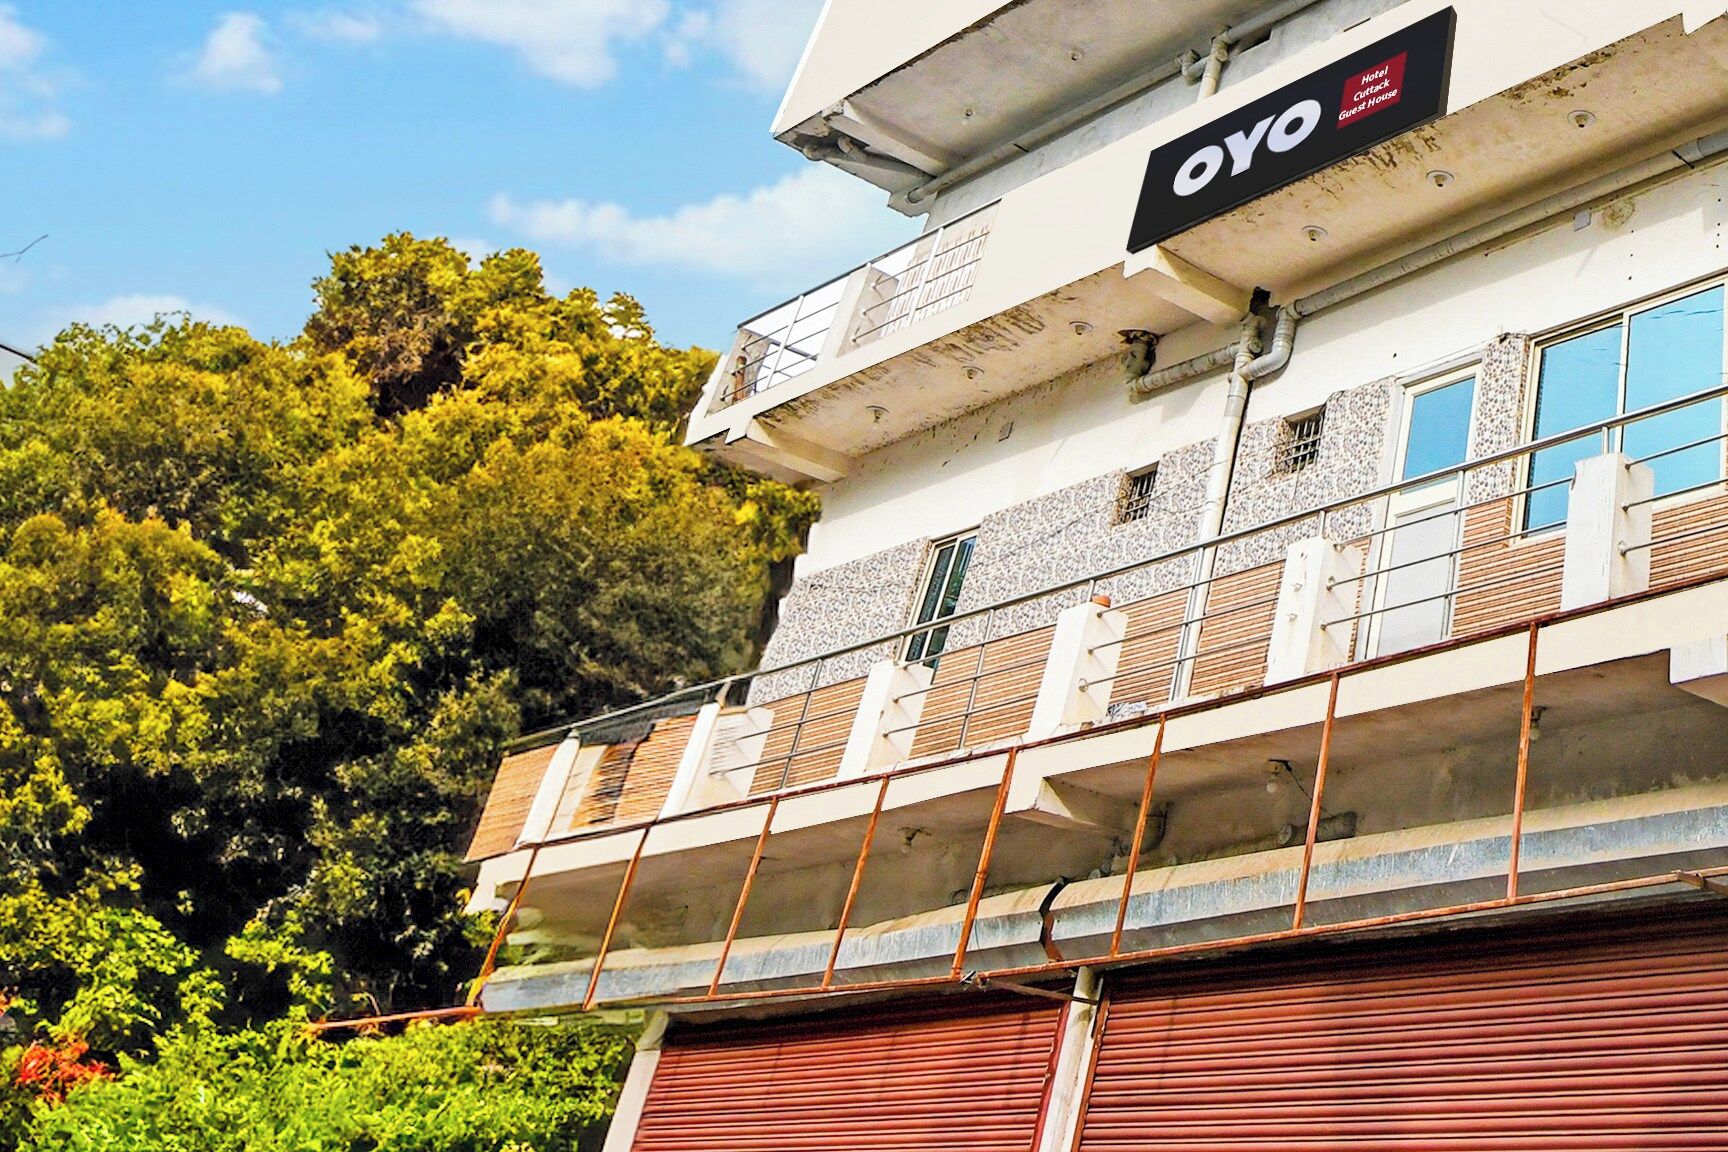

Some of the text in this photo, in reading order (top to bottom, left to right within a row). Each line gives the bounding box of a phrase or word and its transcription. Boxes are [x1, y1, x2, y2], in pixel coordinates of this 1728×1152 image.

[1361, 65, 1389, 85] Hotel
[1353, 78, 1390, 102] Cuttack
[1338, 89, 1398, 121] Guest House
[1173, 99, 1322, 197] OYO
